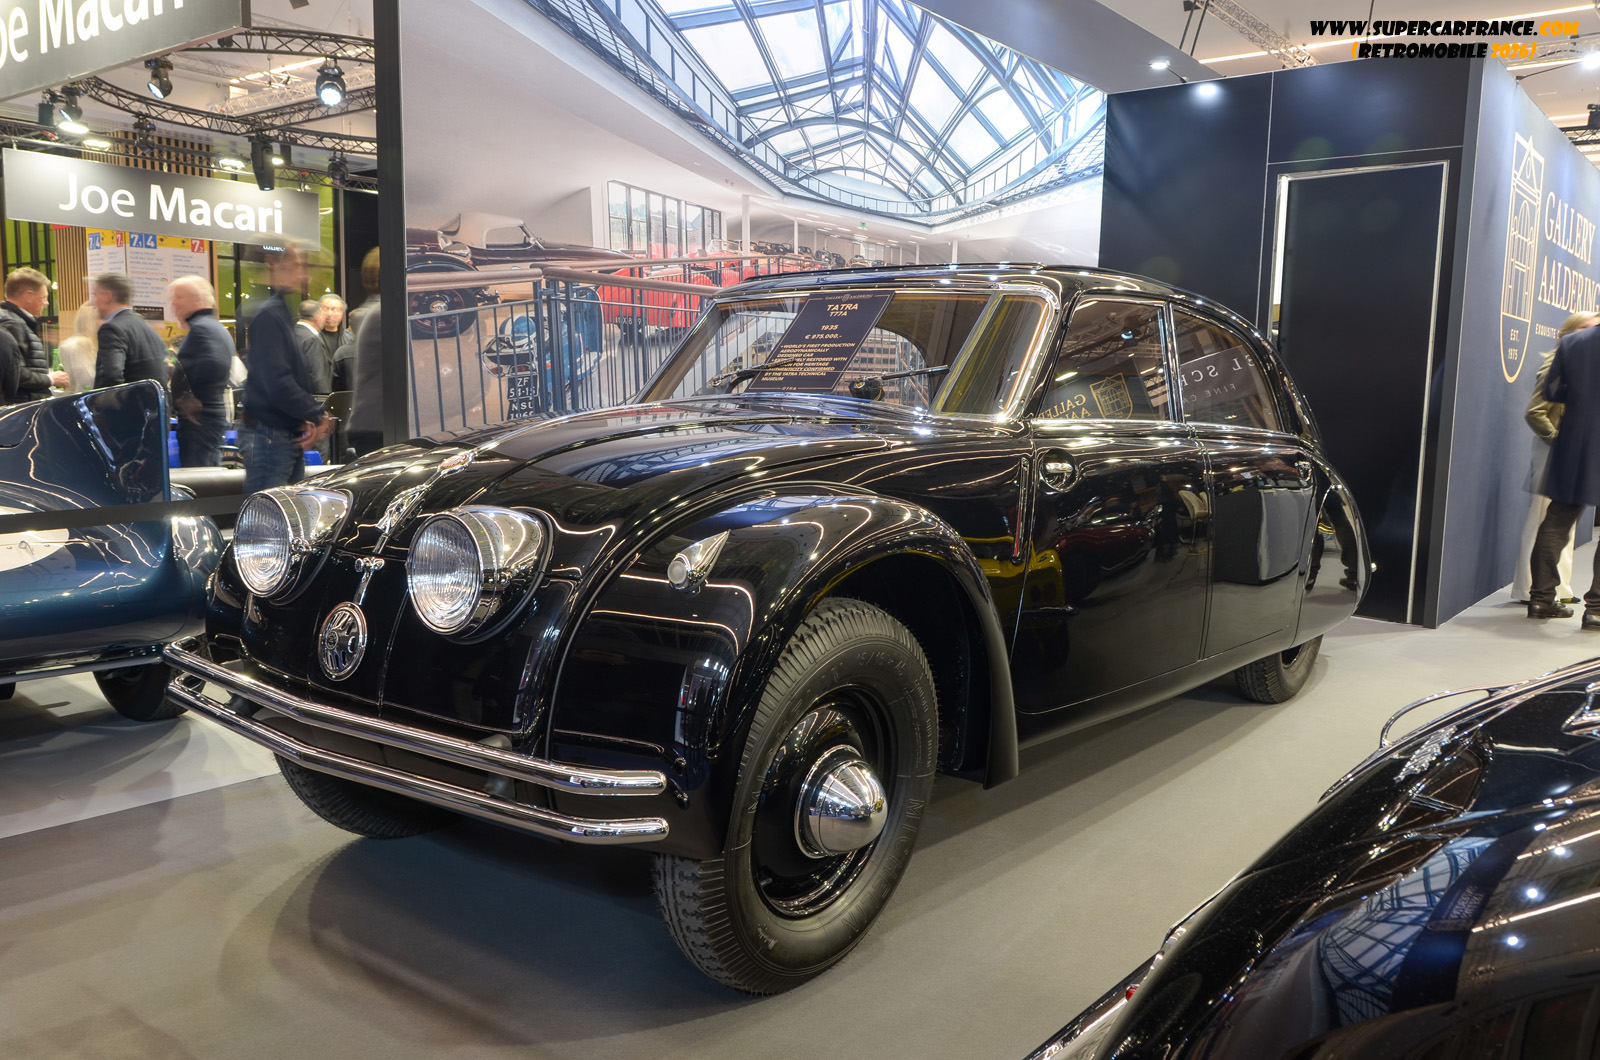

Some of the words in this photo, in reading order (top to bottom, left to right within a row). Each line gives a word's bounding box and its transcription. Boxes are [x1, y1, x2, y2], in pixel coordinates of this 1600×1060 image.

[39, 0, 184, 54] Maca
[58, 172, 136, 218] Joe
[149, 183, 283, 235] Macari
[1545, 192, 1596, 265] GALLERY
[827, 303, 859, 311] TATRA
[517, 377, 530, 387] ZF
